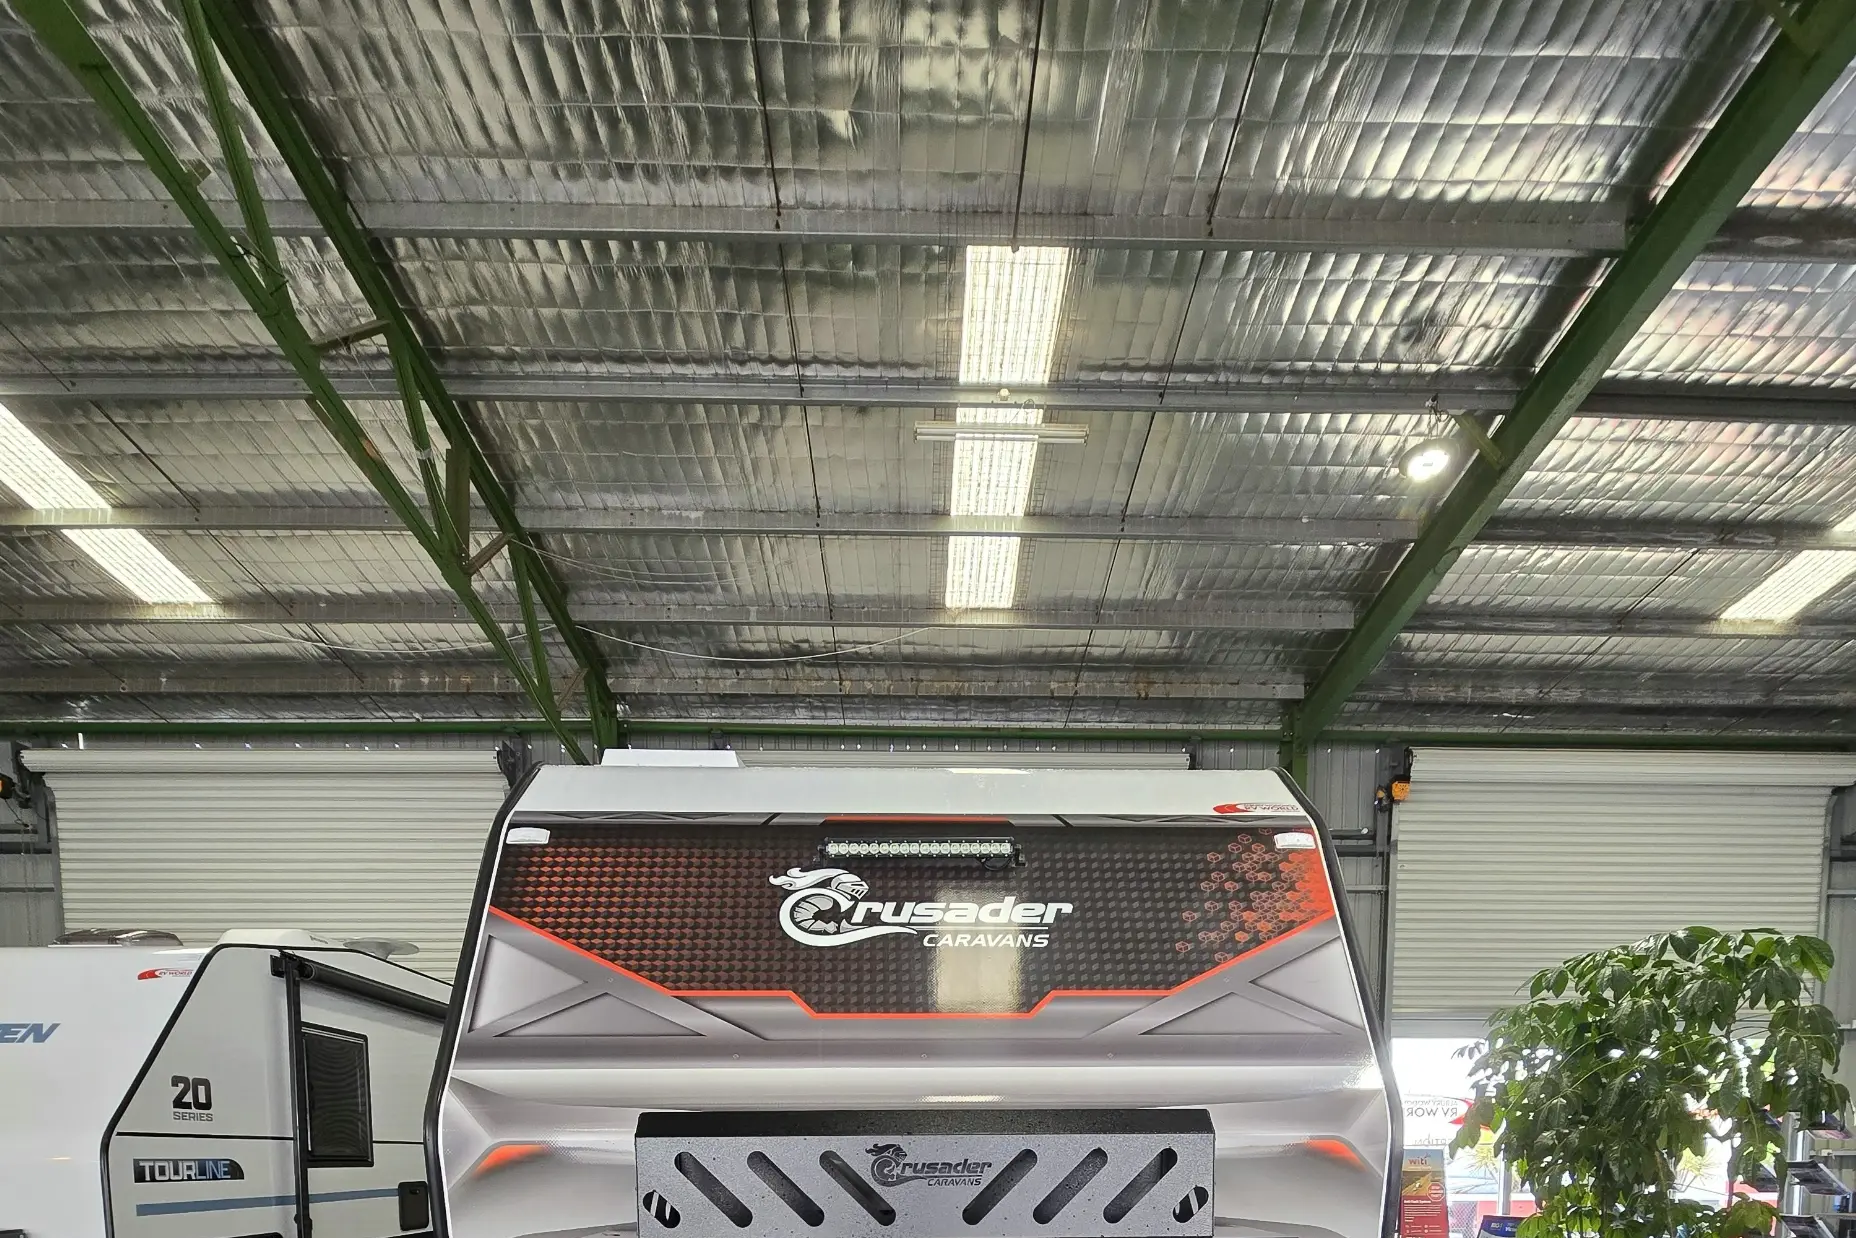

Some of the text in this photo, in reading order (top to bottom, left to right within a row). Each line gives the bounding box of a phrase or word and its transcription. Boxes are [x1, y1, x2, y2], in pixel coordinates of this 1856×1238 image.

[779, 884, 1074, 947] Crusader
[923, 933, 1050, 948] CARAVANS
[170, 1075, 212, 1111] 20
[173, 1111, 214, 1122] SERIES
[139, 1160, 231, 1181] TOURLINE
[871, 1155, 993, 1187] Crusader
[927, 1178, 982, 1186] CARAVANS
